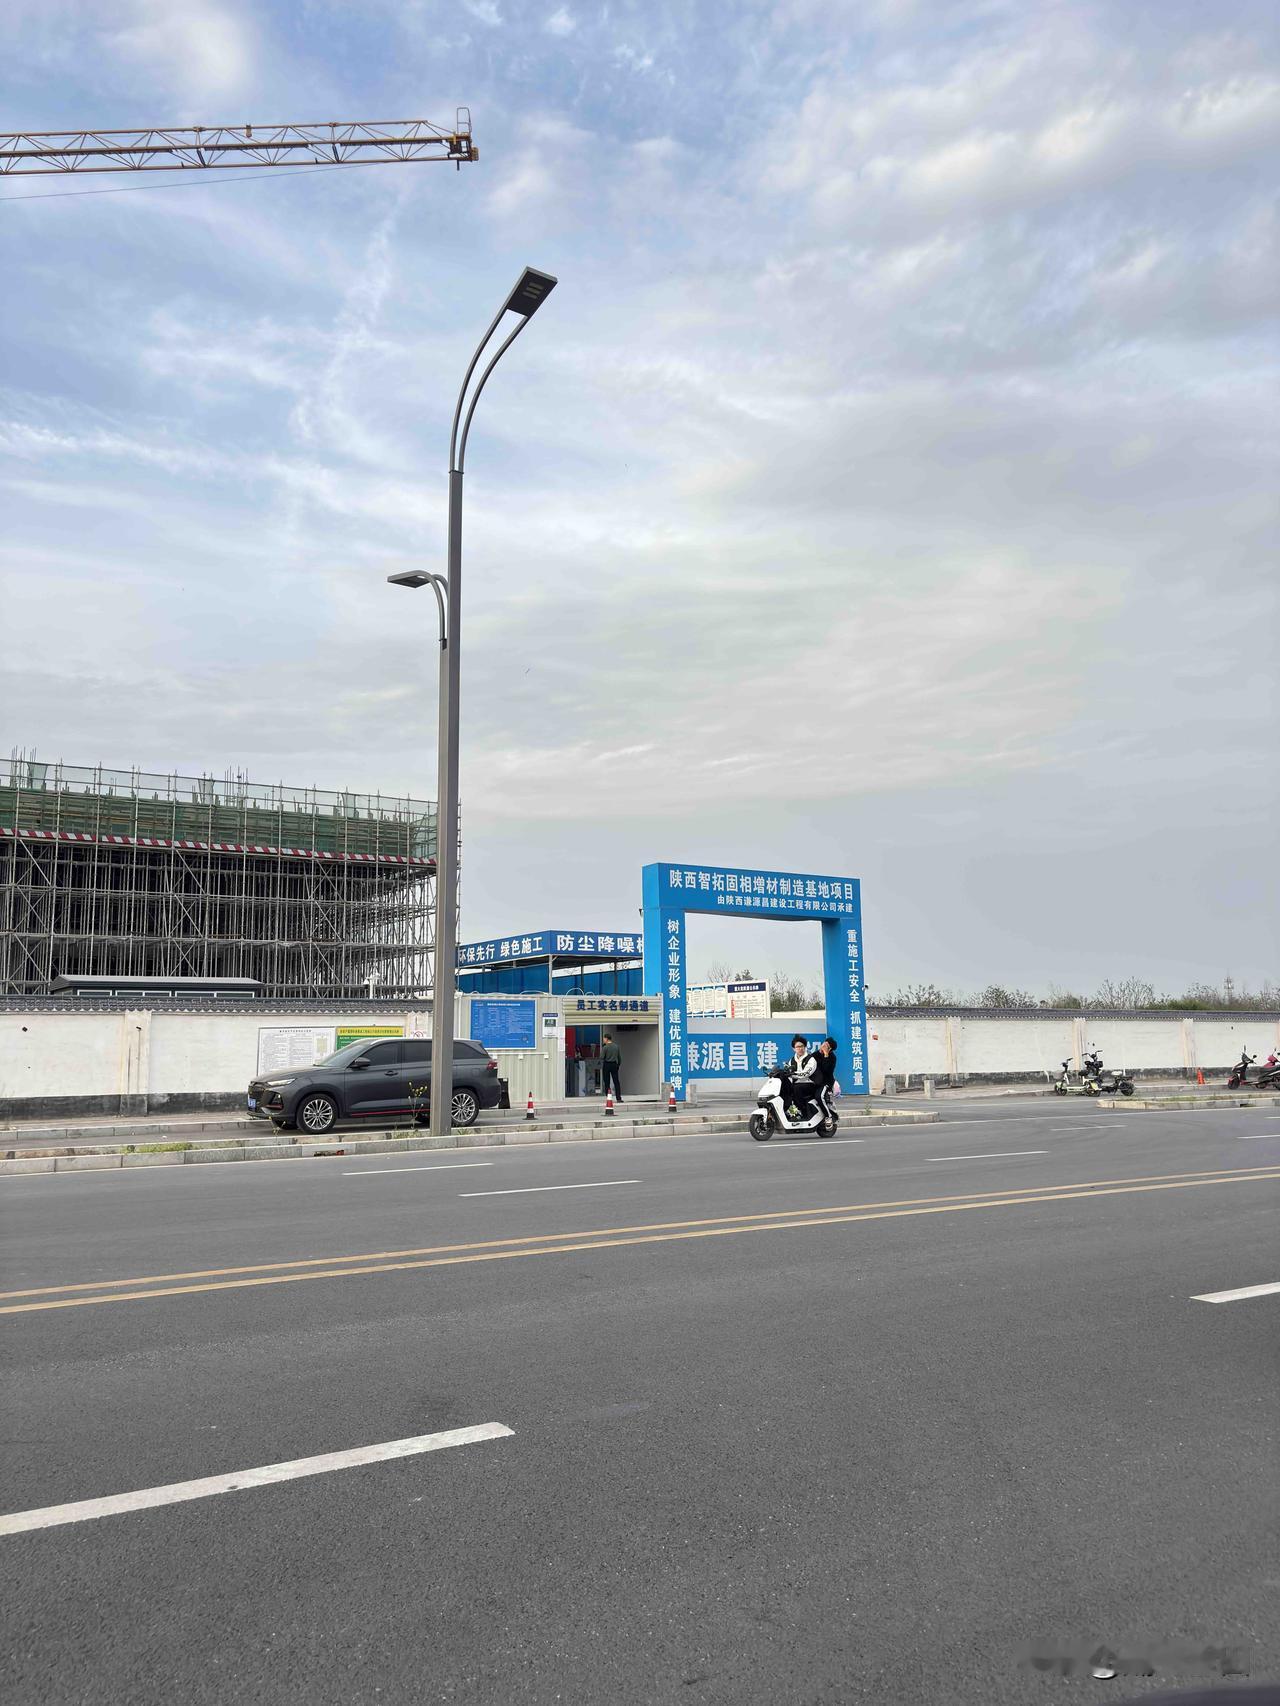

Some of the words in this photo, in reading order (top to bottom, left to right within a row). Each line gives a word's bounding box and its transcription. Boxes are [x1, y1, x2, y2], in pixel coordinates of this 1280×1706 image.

[669, 869, 853, 900] 陕西智拓固相增材制造基地项目
[500, 937, 543, 957] 绿色施工
[667, 919, 681, 999] 树企业形象
[847, 929, 860, 1003] 重施工安全
[576, 999, 649, 1012] 员工实名制通道
[669, 1009, 682, 1091] 建优质品牌
[850, 1011, 864, 1086] 抓建筑质量
